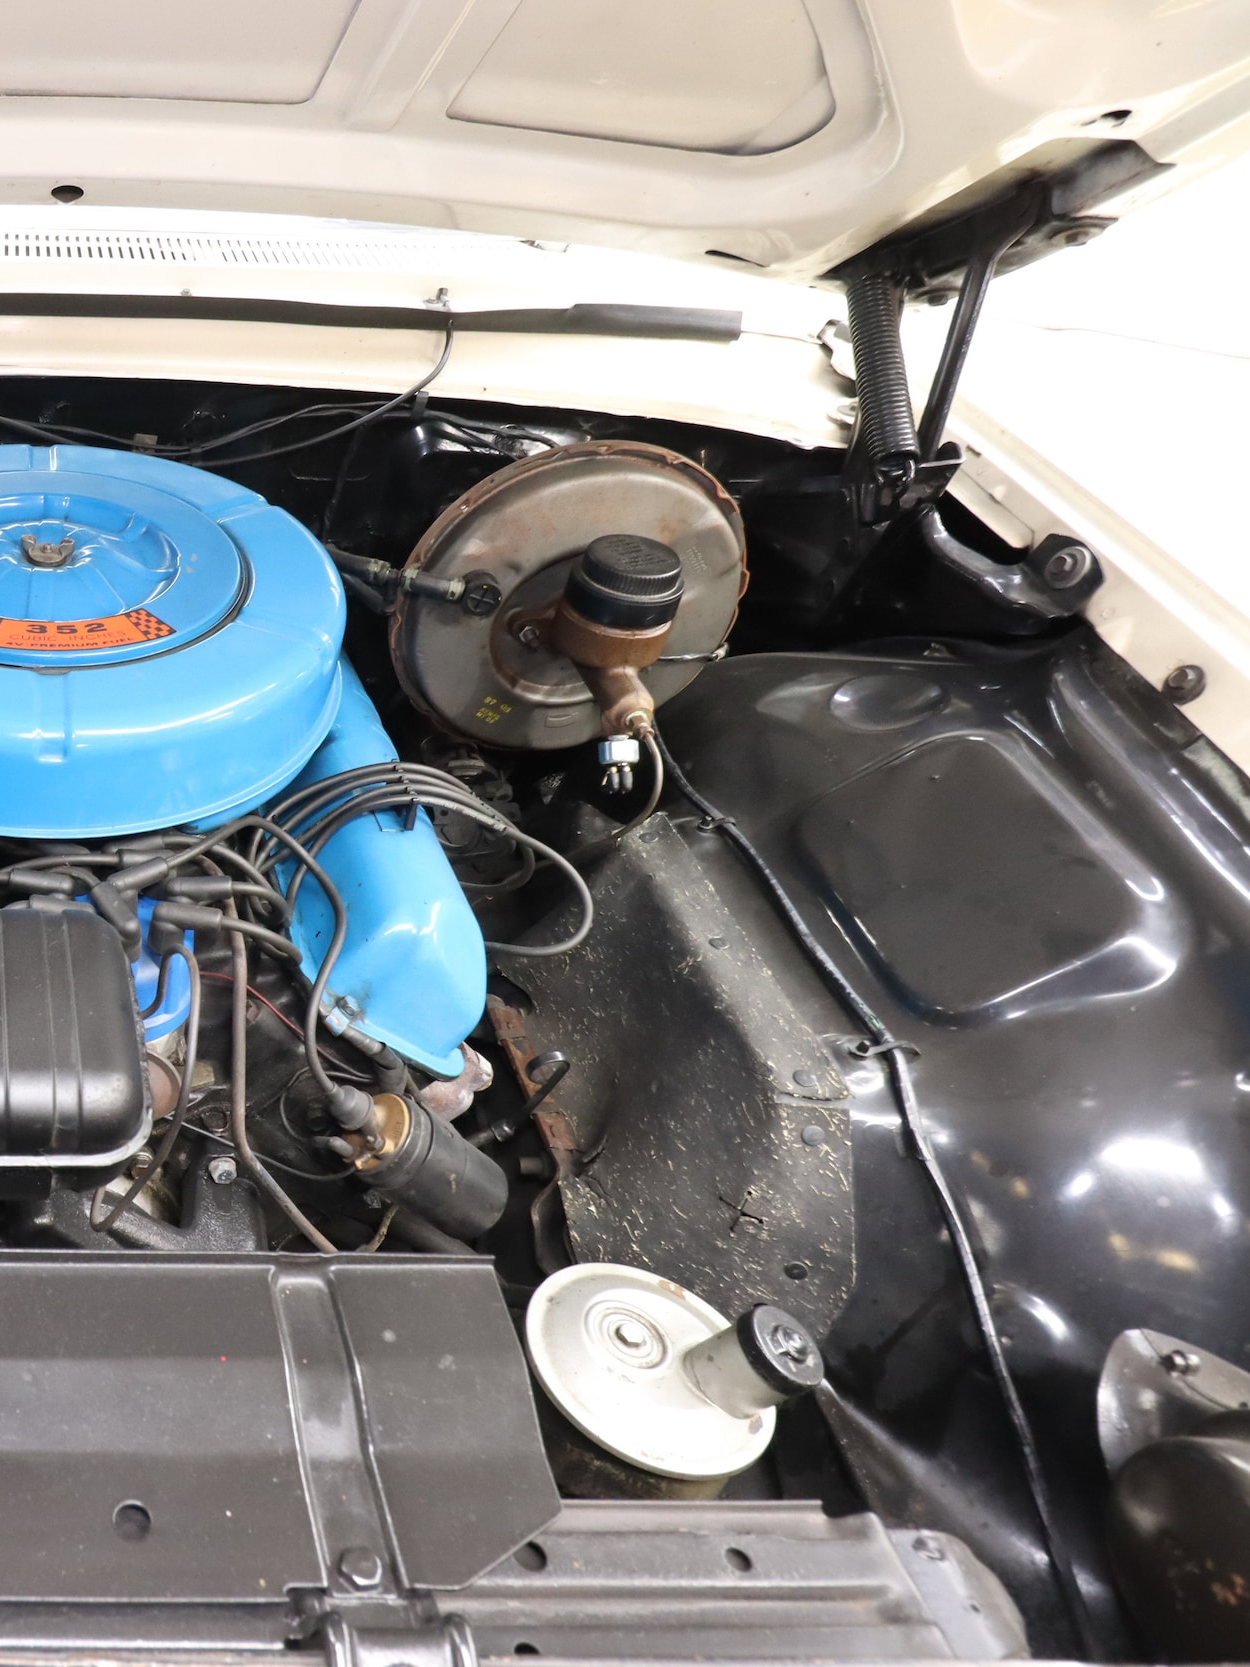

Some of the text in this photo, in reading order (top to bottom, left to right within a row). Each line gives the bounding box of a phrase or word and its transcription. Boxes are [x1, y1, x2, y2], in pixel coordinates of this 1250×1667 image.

[26, 622, 107, 635] 352
[10, 630, 126, 642] CUBIC INCHES
[30, 640, 99, 648] PREMIUM
[102, 636, 135, 646] FUEL
